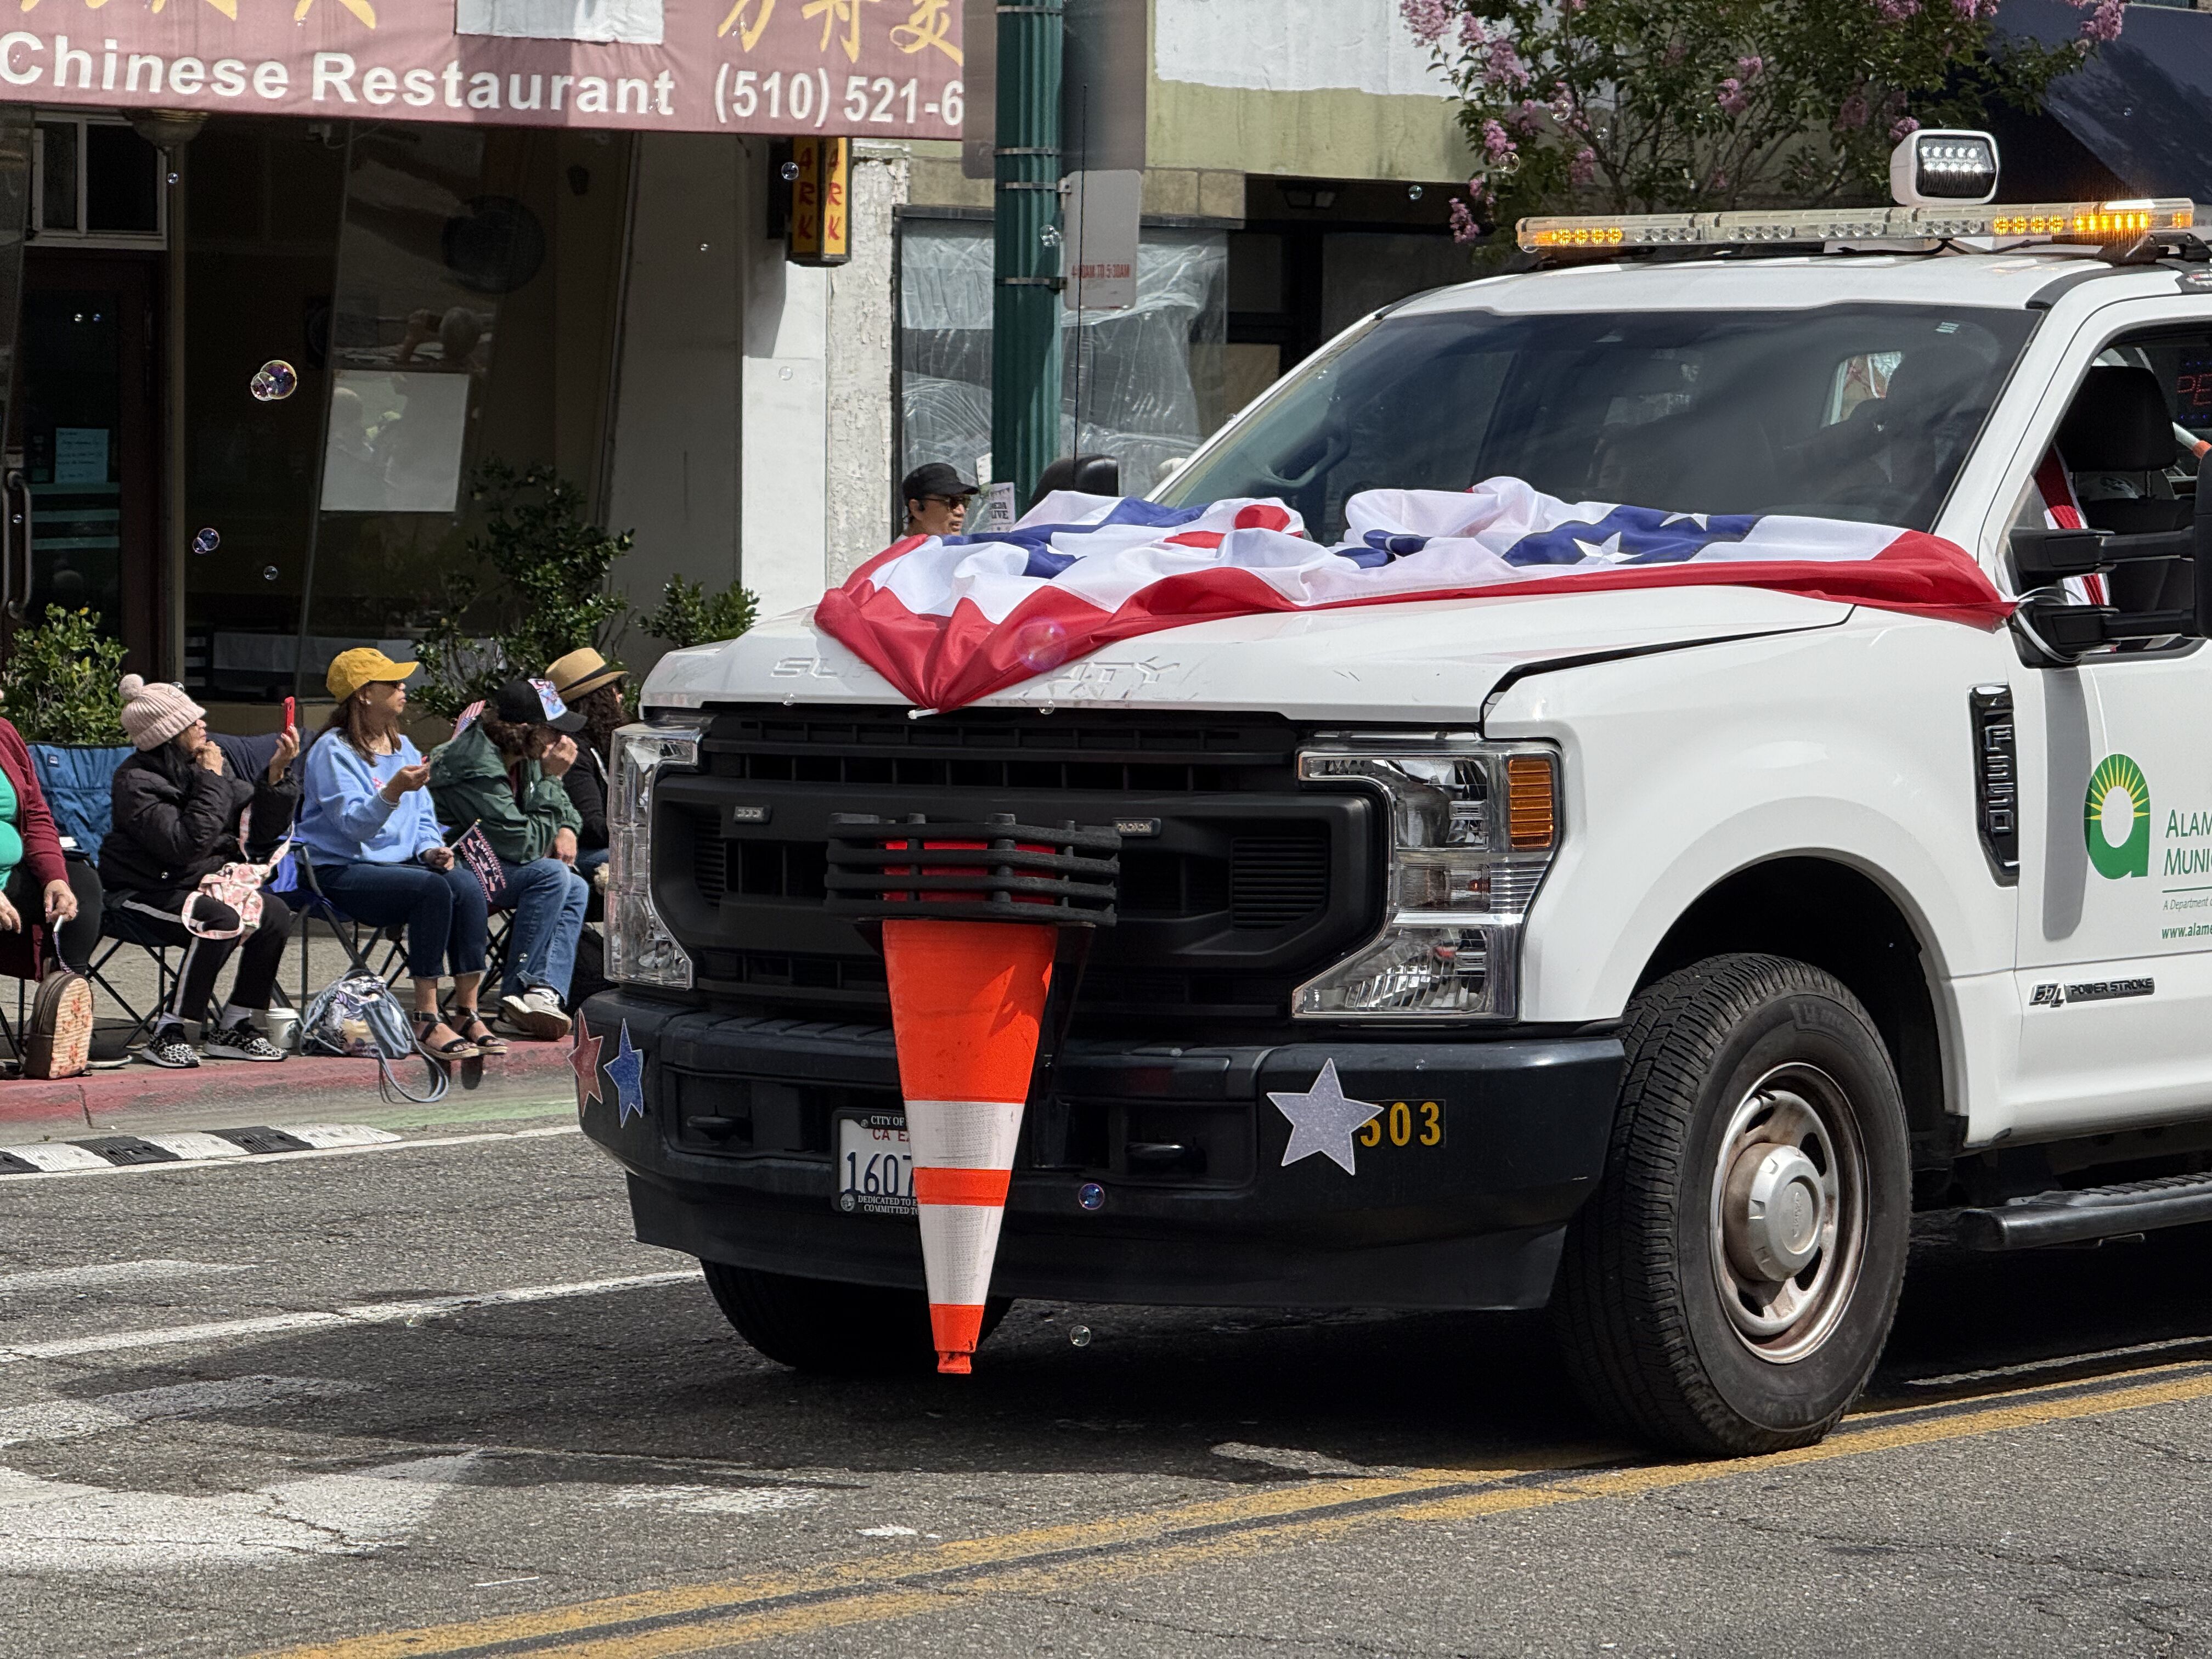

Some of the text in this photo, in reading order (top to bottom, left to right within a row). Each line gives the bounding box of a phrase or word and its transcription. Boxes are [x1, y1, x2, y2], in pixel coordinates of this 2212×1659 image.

[0, 31, 963, 128] Chinese Restaurant (510) 521-6
[1097, 264, 1104, 278] TO
[2165, 809, 2212, 838] ALAM
[2164, 848, 2212, 876] MUNI
[2170, 896, 2209, 911] Department
[2070, 982, 2108, 995] POWER
[2109, 978, 2153, 992] STROKE
[871, 1115, 905, 1126] CITY OF
[872, 1128, 890, 1141] CA
[857, 1194, 900, 1206] DEDICATED
[901, 1198, 911, 1206] TO
[864, 1204, 910, 1214] COMMITTED
